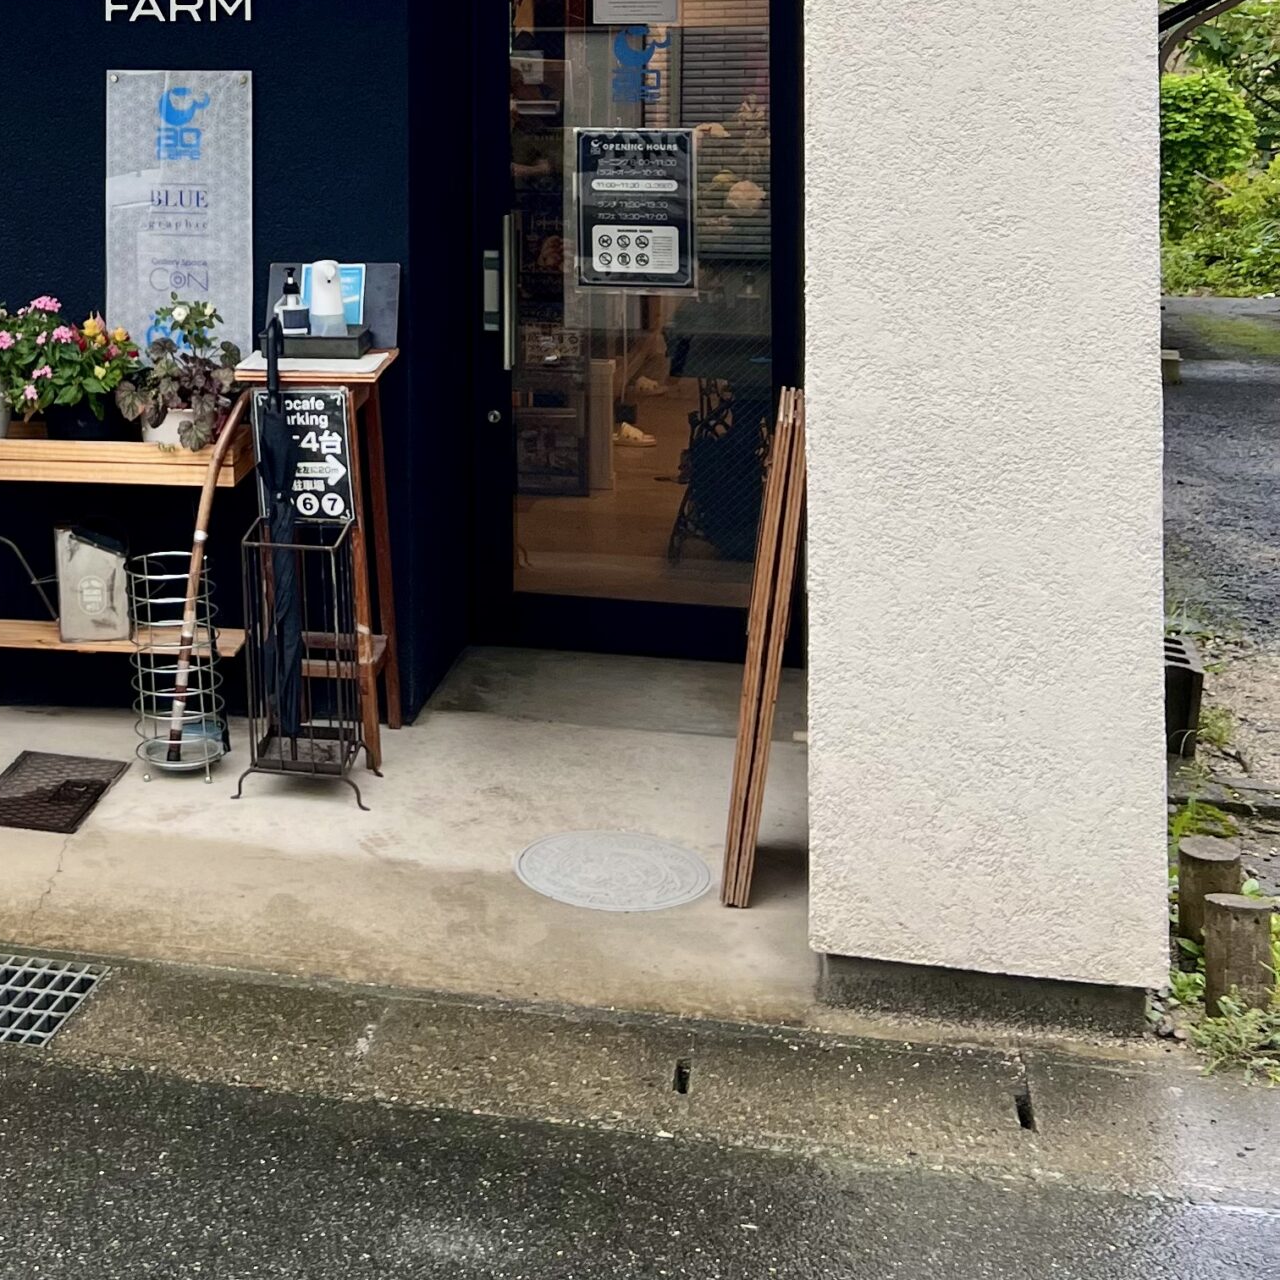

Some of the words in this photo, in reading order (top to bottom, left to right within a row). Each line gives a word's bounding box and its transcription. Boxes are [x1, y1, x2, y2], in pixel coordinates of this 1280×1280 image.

[602, 143, 644, 151] OPENING
[646, 143, 679, 151] HOURS
[150, 189, 209, 209] BLUE
[284, 396, 325, 411] ocafe
[286, 412, 329, 428] rking
